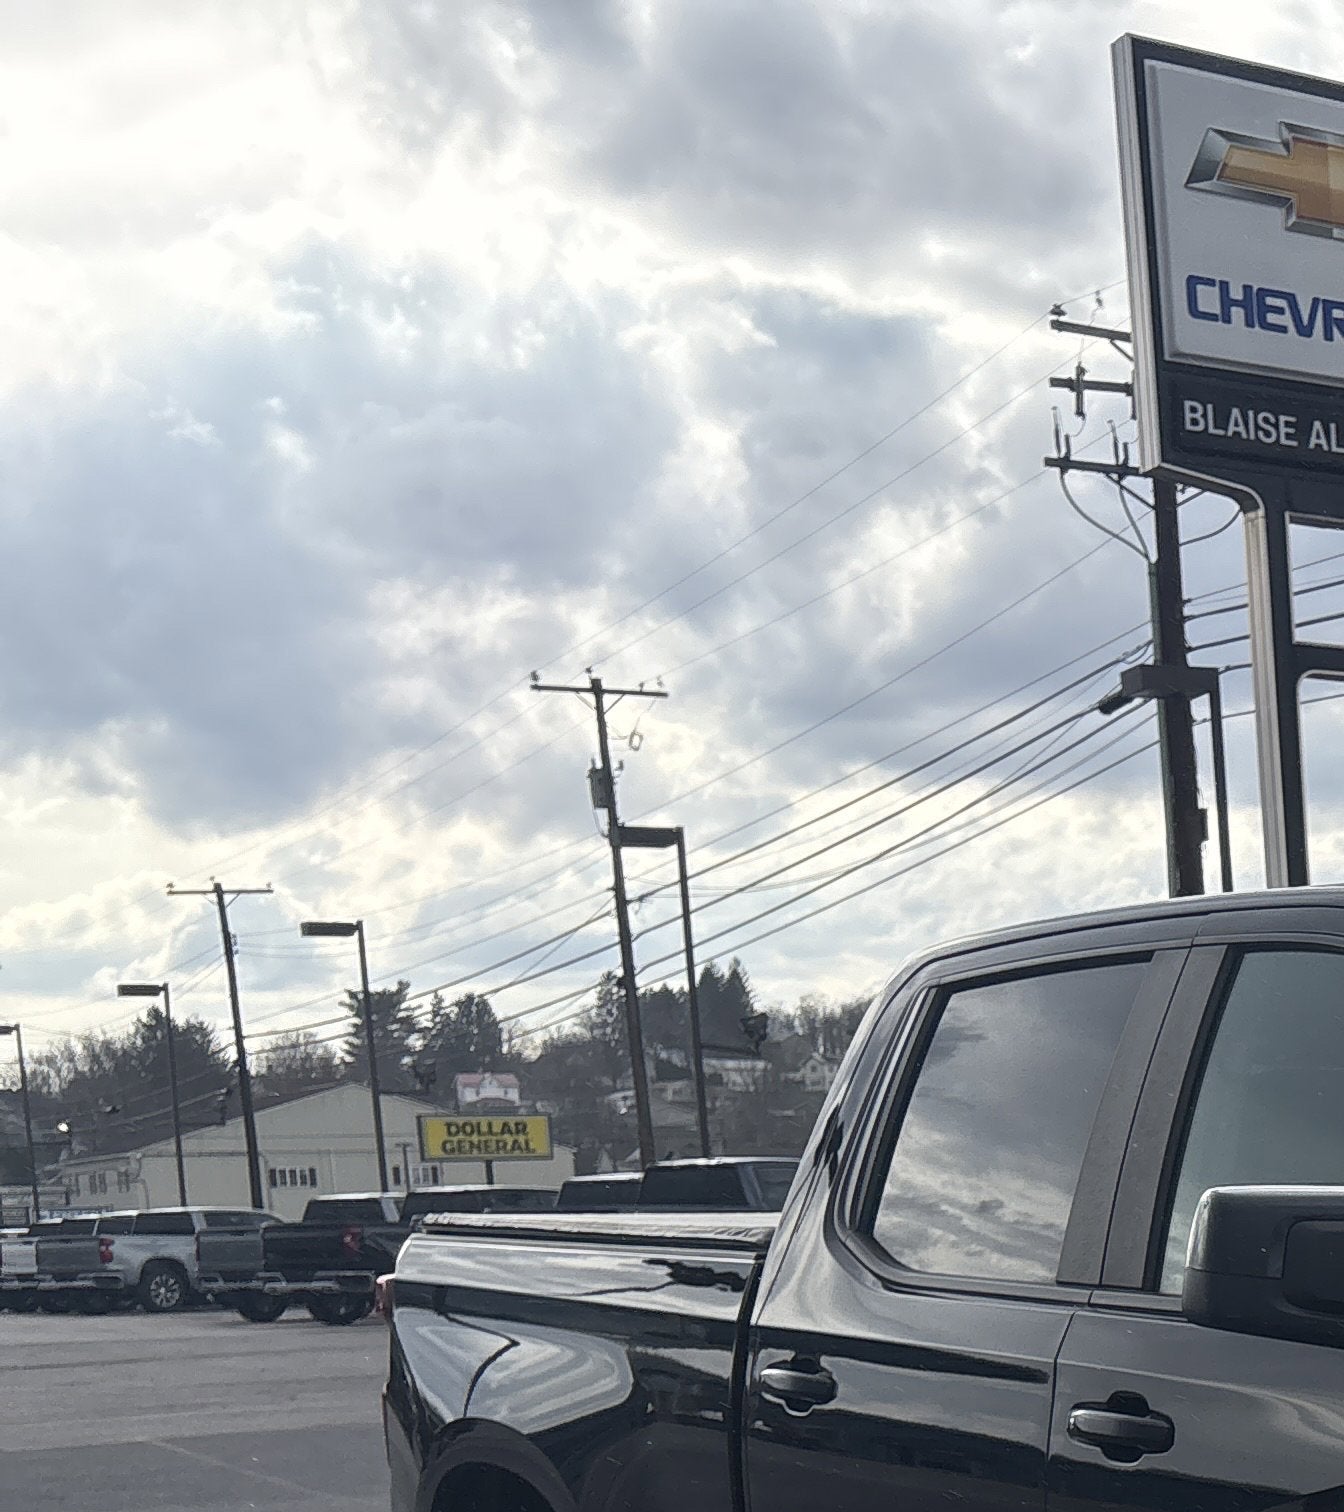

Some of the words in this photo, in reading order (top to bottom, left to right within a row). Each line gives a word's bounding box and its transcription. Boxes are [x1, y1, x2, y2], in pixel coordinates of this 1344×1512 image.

[1184, 400, 1299, 447] BLAISE
[444, 1121, 528, 1138] DOLLAR
[441, 1138, 536, 1155] GENERAL
